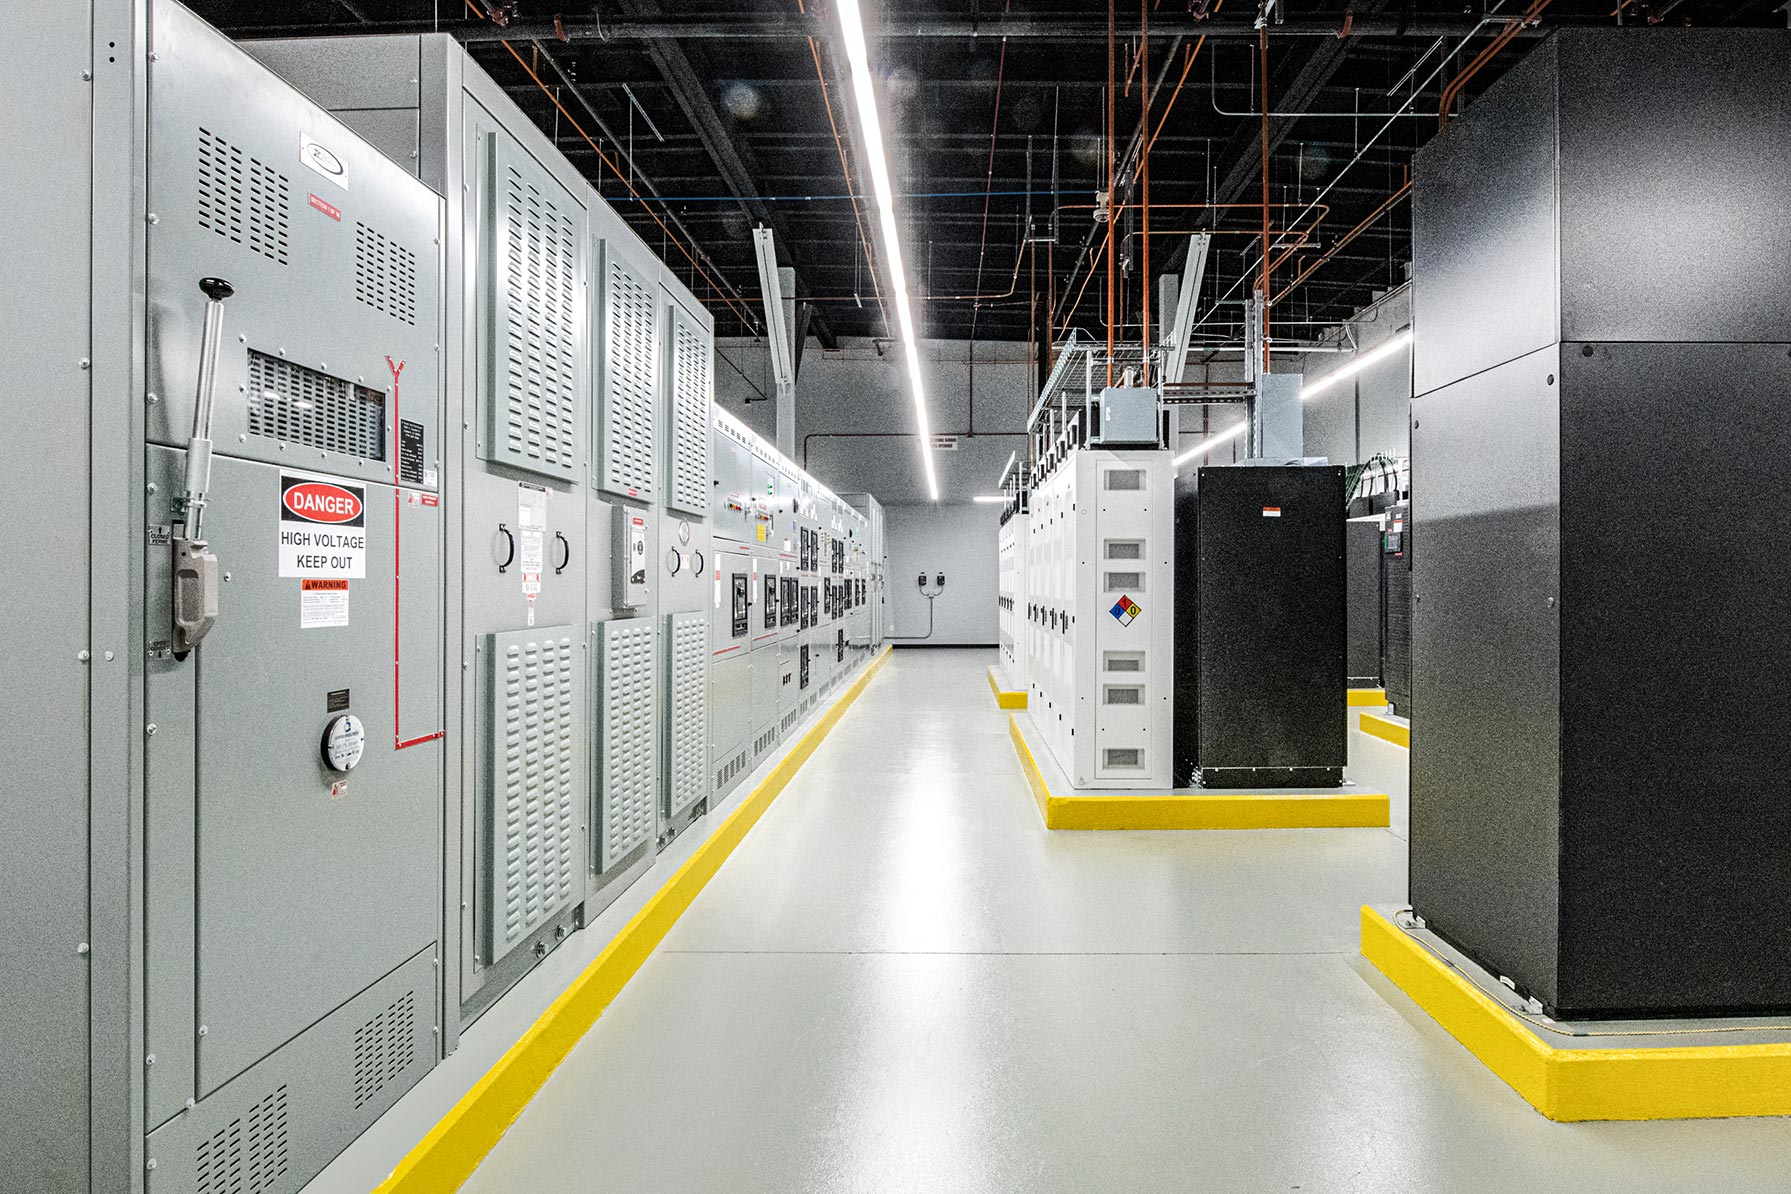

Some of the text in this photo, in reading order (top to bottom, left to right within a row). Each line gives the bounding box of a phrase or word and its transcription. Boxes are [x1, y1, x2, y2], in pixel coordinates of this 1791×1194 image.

[293, 491, 354, 515] DANGER
[281, 531, 364, 549] HIGH VOLTAGE
[297, 554, 353, 569] KEEP OUT
[311, 580, 346, 589] WARNING
[1122, 599, 1126, 608] 1
[1114, 606, 1136, 615] 0 0
